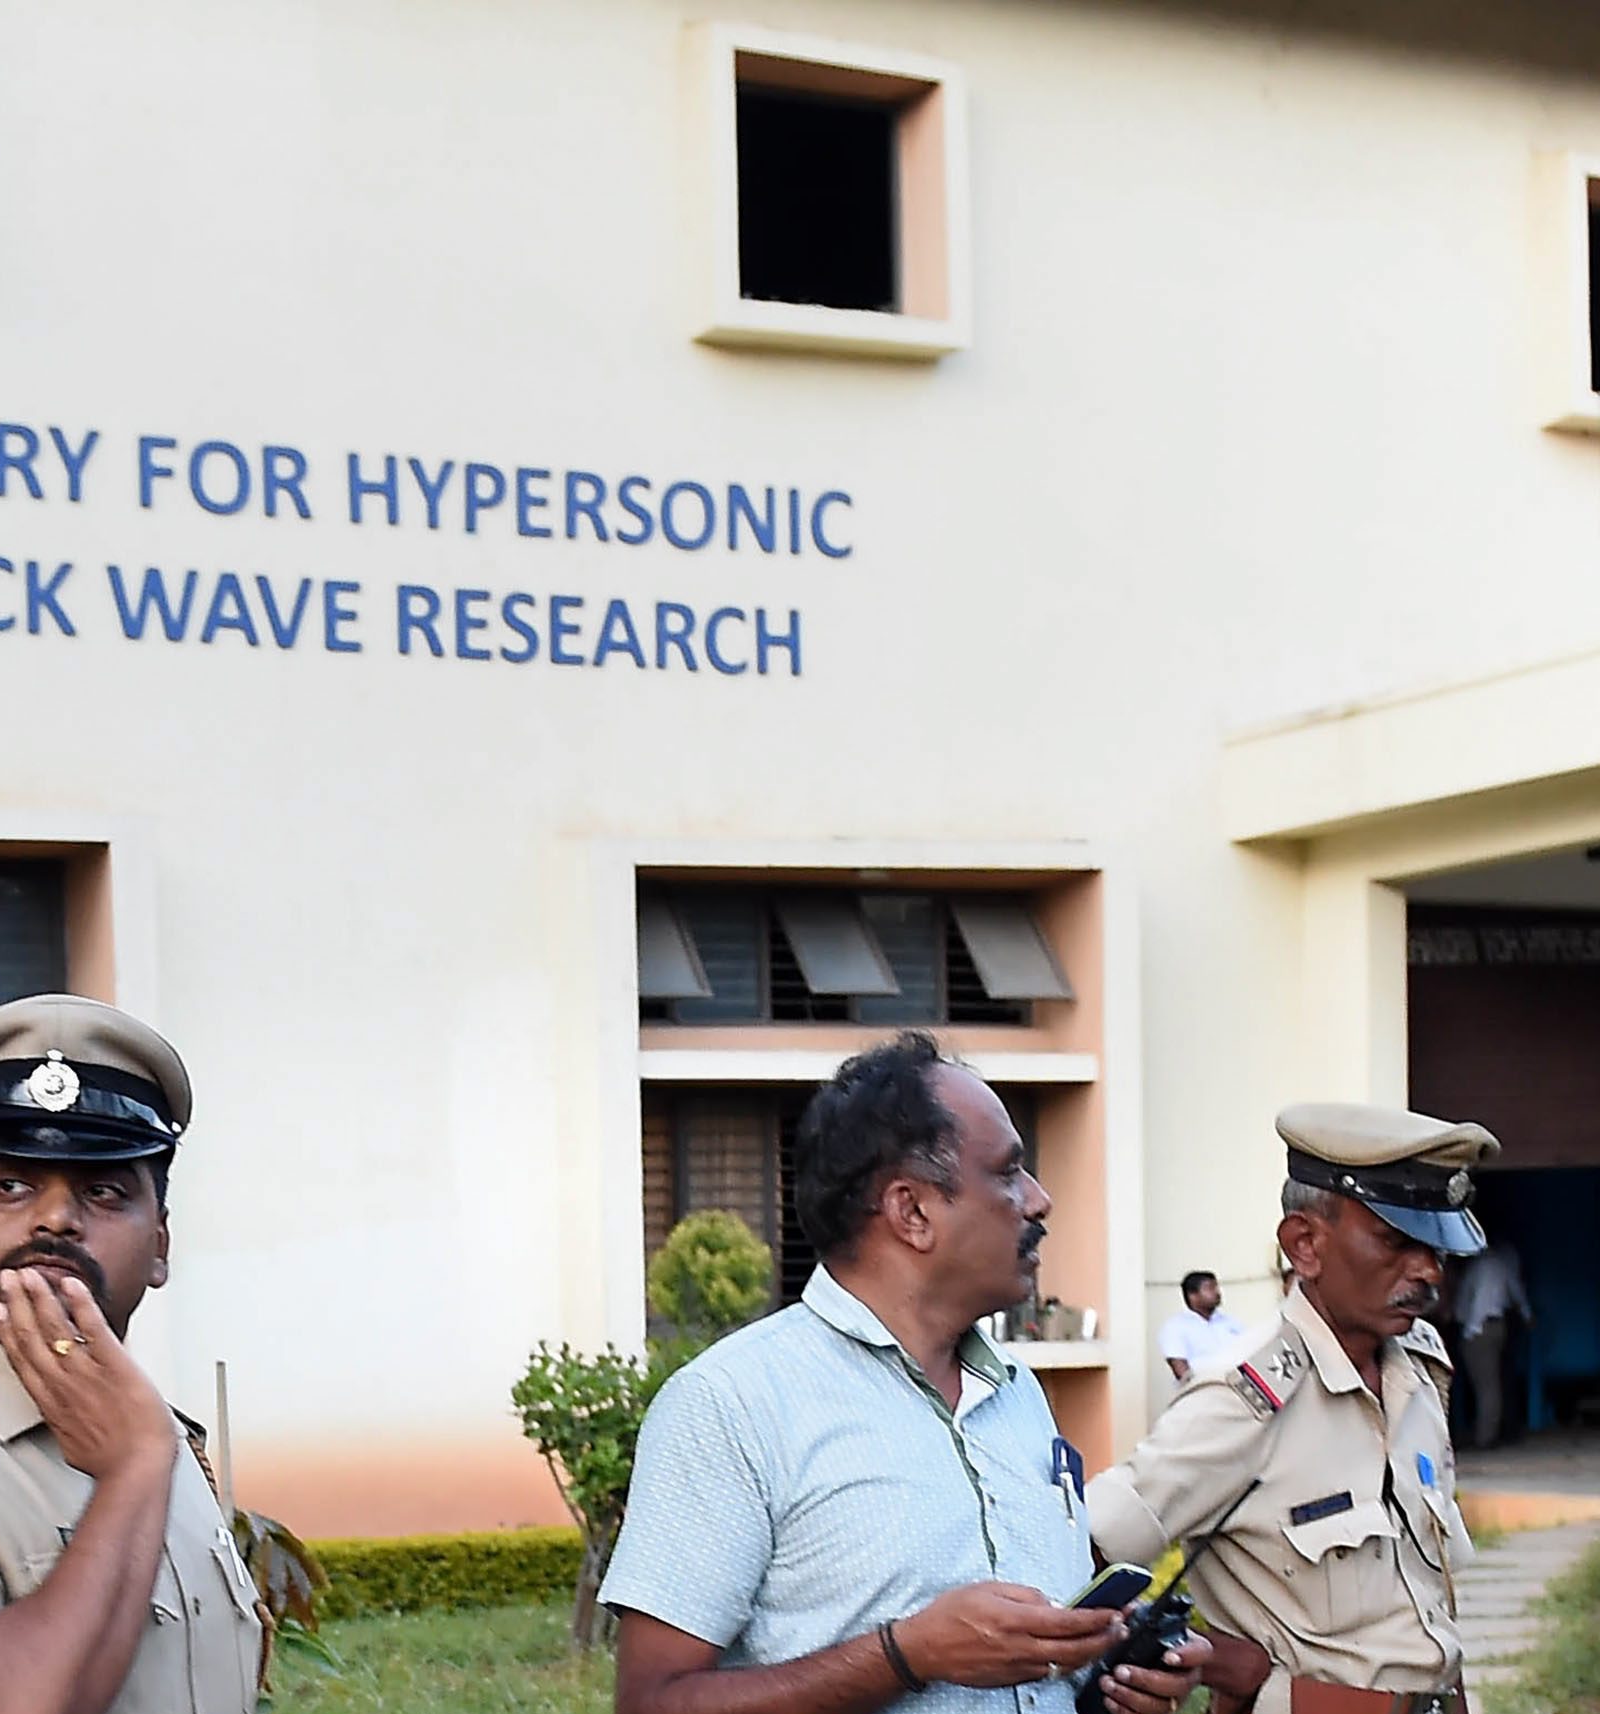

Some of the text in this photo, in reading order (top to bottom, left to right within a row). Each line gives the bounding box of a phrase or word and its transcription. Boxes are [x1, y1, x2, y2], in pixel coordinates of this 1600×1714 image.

[137, 434, 313, 519] FOR
[346, 453, 852, 559] HYPERSONIC
[106, 565, 363, 654] WAVE
[396, 583, 804, 675] RESEARCH
